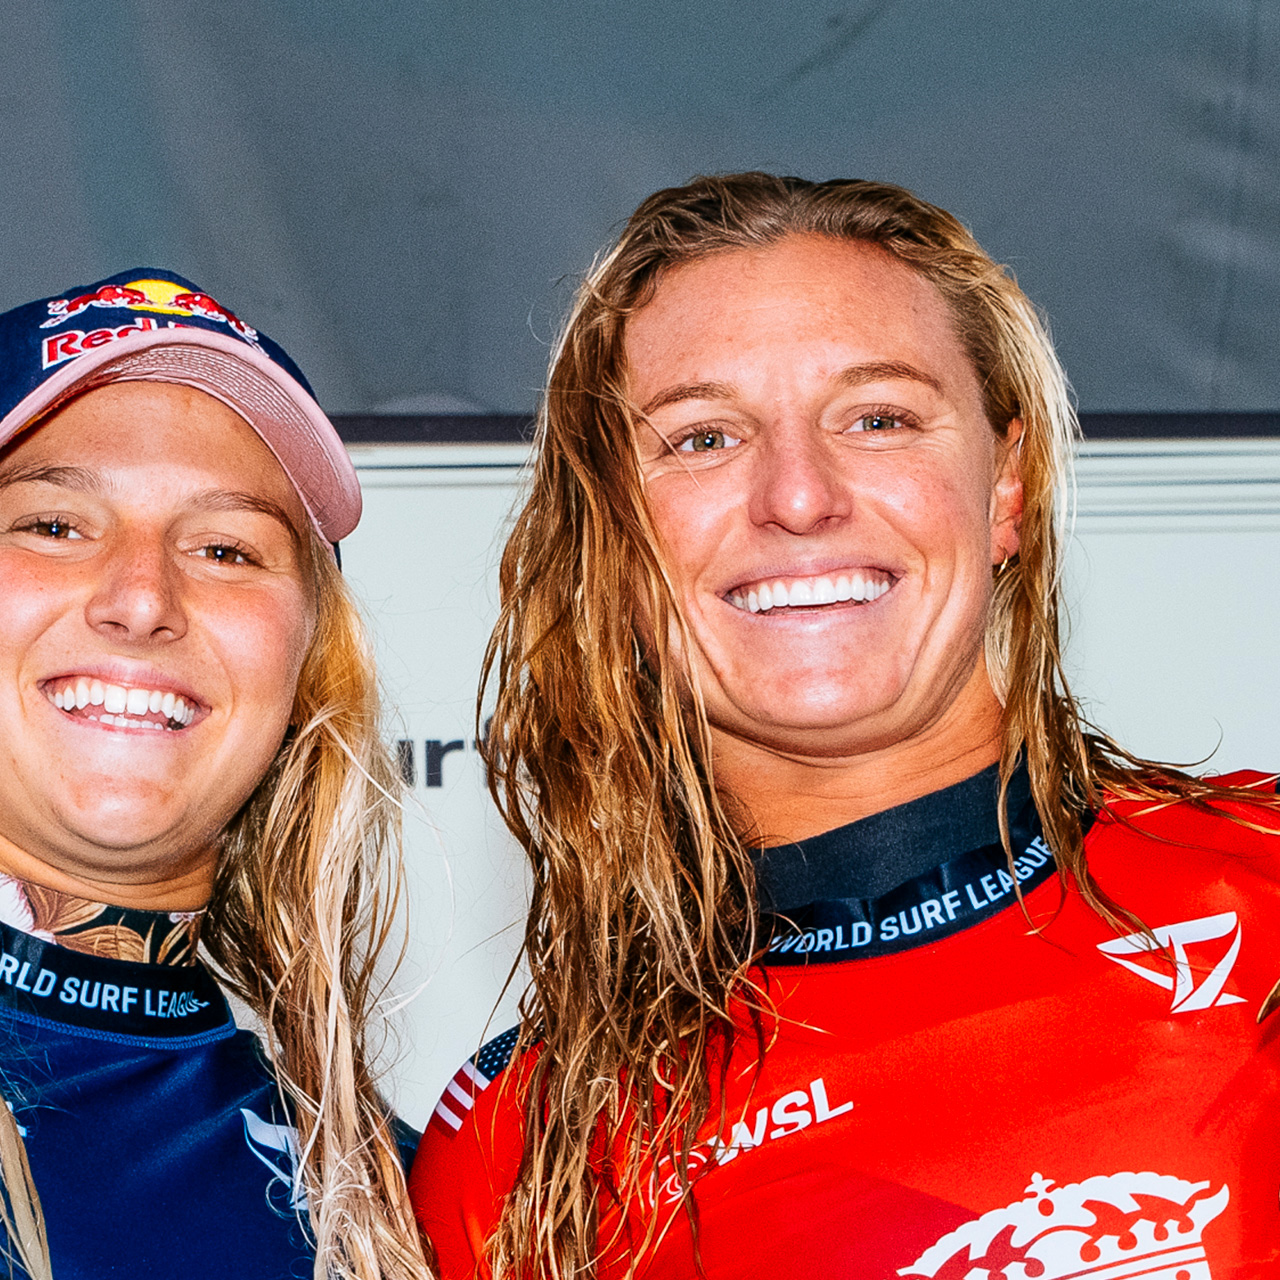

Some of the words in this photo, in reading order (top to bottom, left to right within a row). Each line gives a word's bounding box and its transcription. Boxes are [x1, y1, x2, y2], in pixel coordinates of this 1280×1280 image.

[769, 921, 872, 954] WORLD
[879, 890, 963, 942] SURF
[965, 835, 1056, 910] LEAGUE
[59, 976, 139, 1014] SURF
[707, 1077, 855, 1167] WSL
